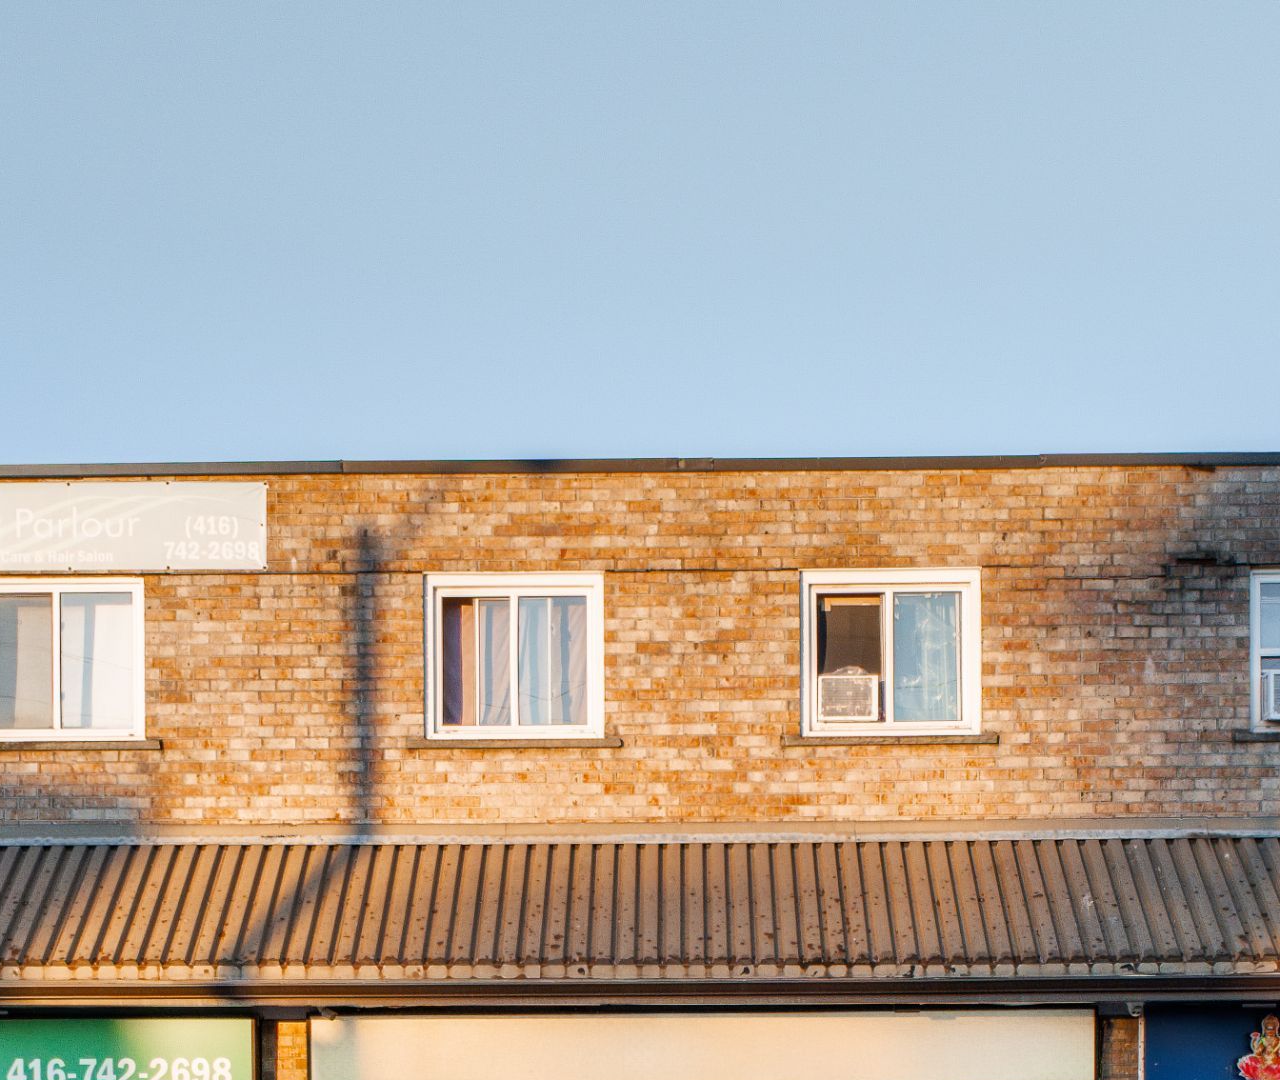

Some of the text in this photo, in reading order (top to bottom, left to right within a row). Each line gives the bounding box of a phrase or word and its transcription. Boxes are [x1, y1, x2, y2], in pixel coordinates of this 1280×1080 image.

[15, 507, 141, 540] Parlour
[184, 516, 239, 540] (416)
[77, 551, 113, 563] Salon
[163, 541, 260, 562] 742-2698
